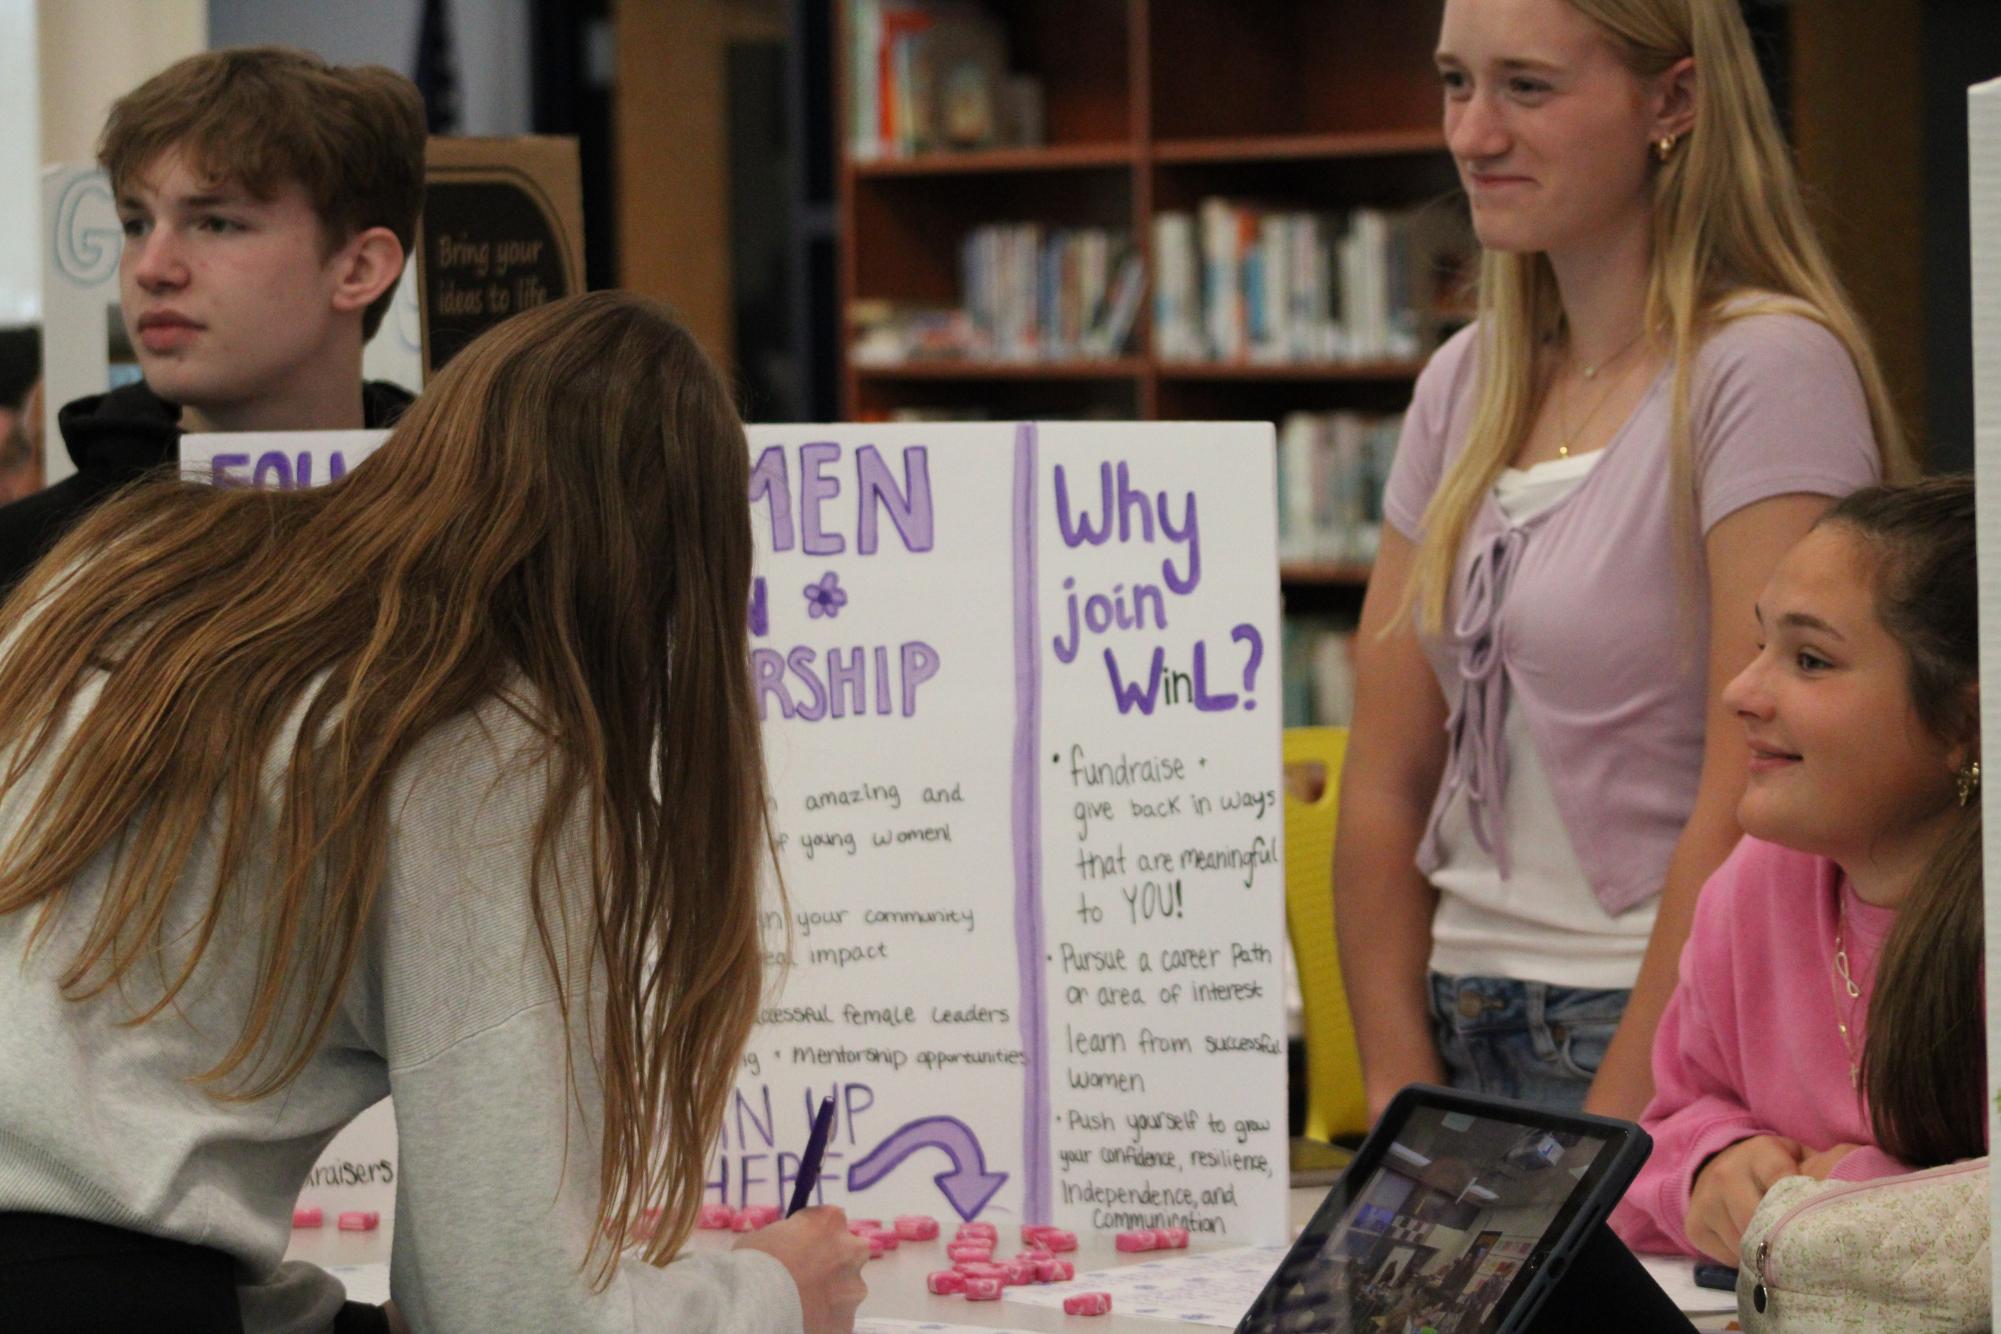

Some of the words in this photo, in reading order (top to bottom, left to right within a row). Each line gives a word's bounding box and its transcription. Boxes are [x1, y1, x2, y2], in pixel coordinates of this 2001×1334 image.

[1053, 460, 1201, 596] Why
[1053, 576, 1168, 664] join
[1070, 743, 1186, 787] fundraise
[804, 782, 902, 812] amazing
[922, 781, 965, 804] and
[1074, 800, 1115, 842] give
[1130, 795, 1182, 818] back
[1190, 793, 1212, 817] in
[1220, 789, 1277, 820] ways
[799, 830, 858, 860] young
[1077, 843, 1127, 881] that
[1137, 852, 1175, 873] are
[1180, 835, 1279, 889] meaningful
[1076, 891, 1104, 924] to
[1122, 878, 1184, 925] YOU!
[797, 910, 849, 937] your
[864, 907, 976, 933] community
[809, 940, 889, 969] impact
[1060, 942, 1129, 975] Pursue
[1138, 954, 1153, 974] a
[1065, 984, 1089, 1006] or
[1098, 985, 1147, 1007] area
[1159, 982, 1183, 1005] of
[1191, 979, 1264, 1003] interest
[842, 1003, 917, 1027] female
[1139, 1027, 1193, 1054] from
[1204, 1032, 1283, 1055] successful
[793, 1045, 908, 1070] Mentorship
[1068, 1109, 1116, 1132] Push
[1126, 1109, 1200, 1143] yourself
[1207, 1112, 1227, 1133] to
[1234, 1119, 1271, 1144] grow
[1060, 1150, 1093, 1172] your
[1191, 1150, 1273, 1178] resilience,
[1201, 1184, 1238, 1207] and
